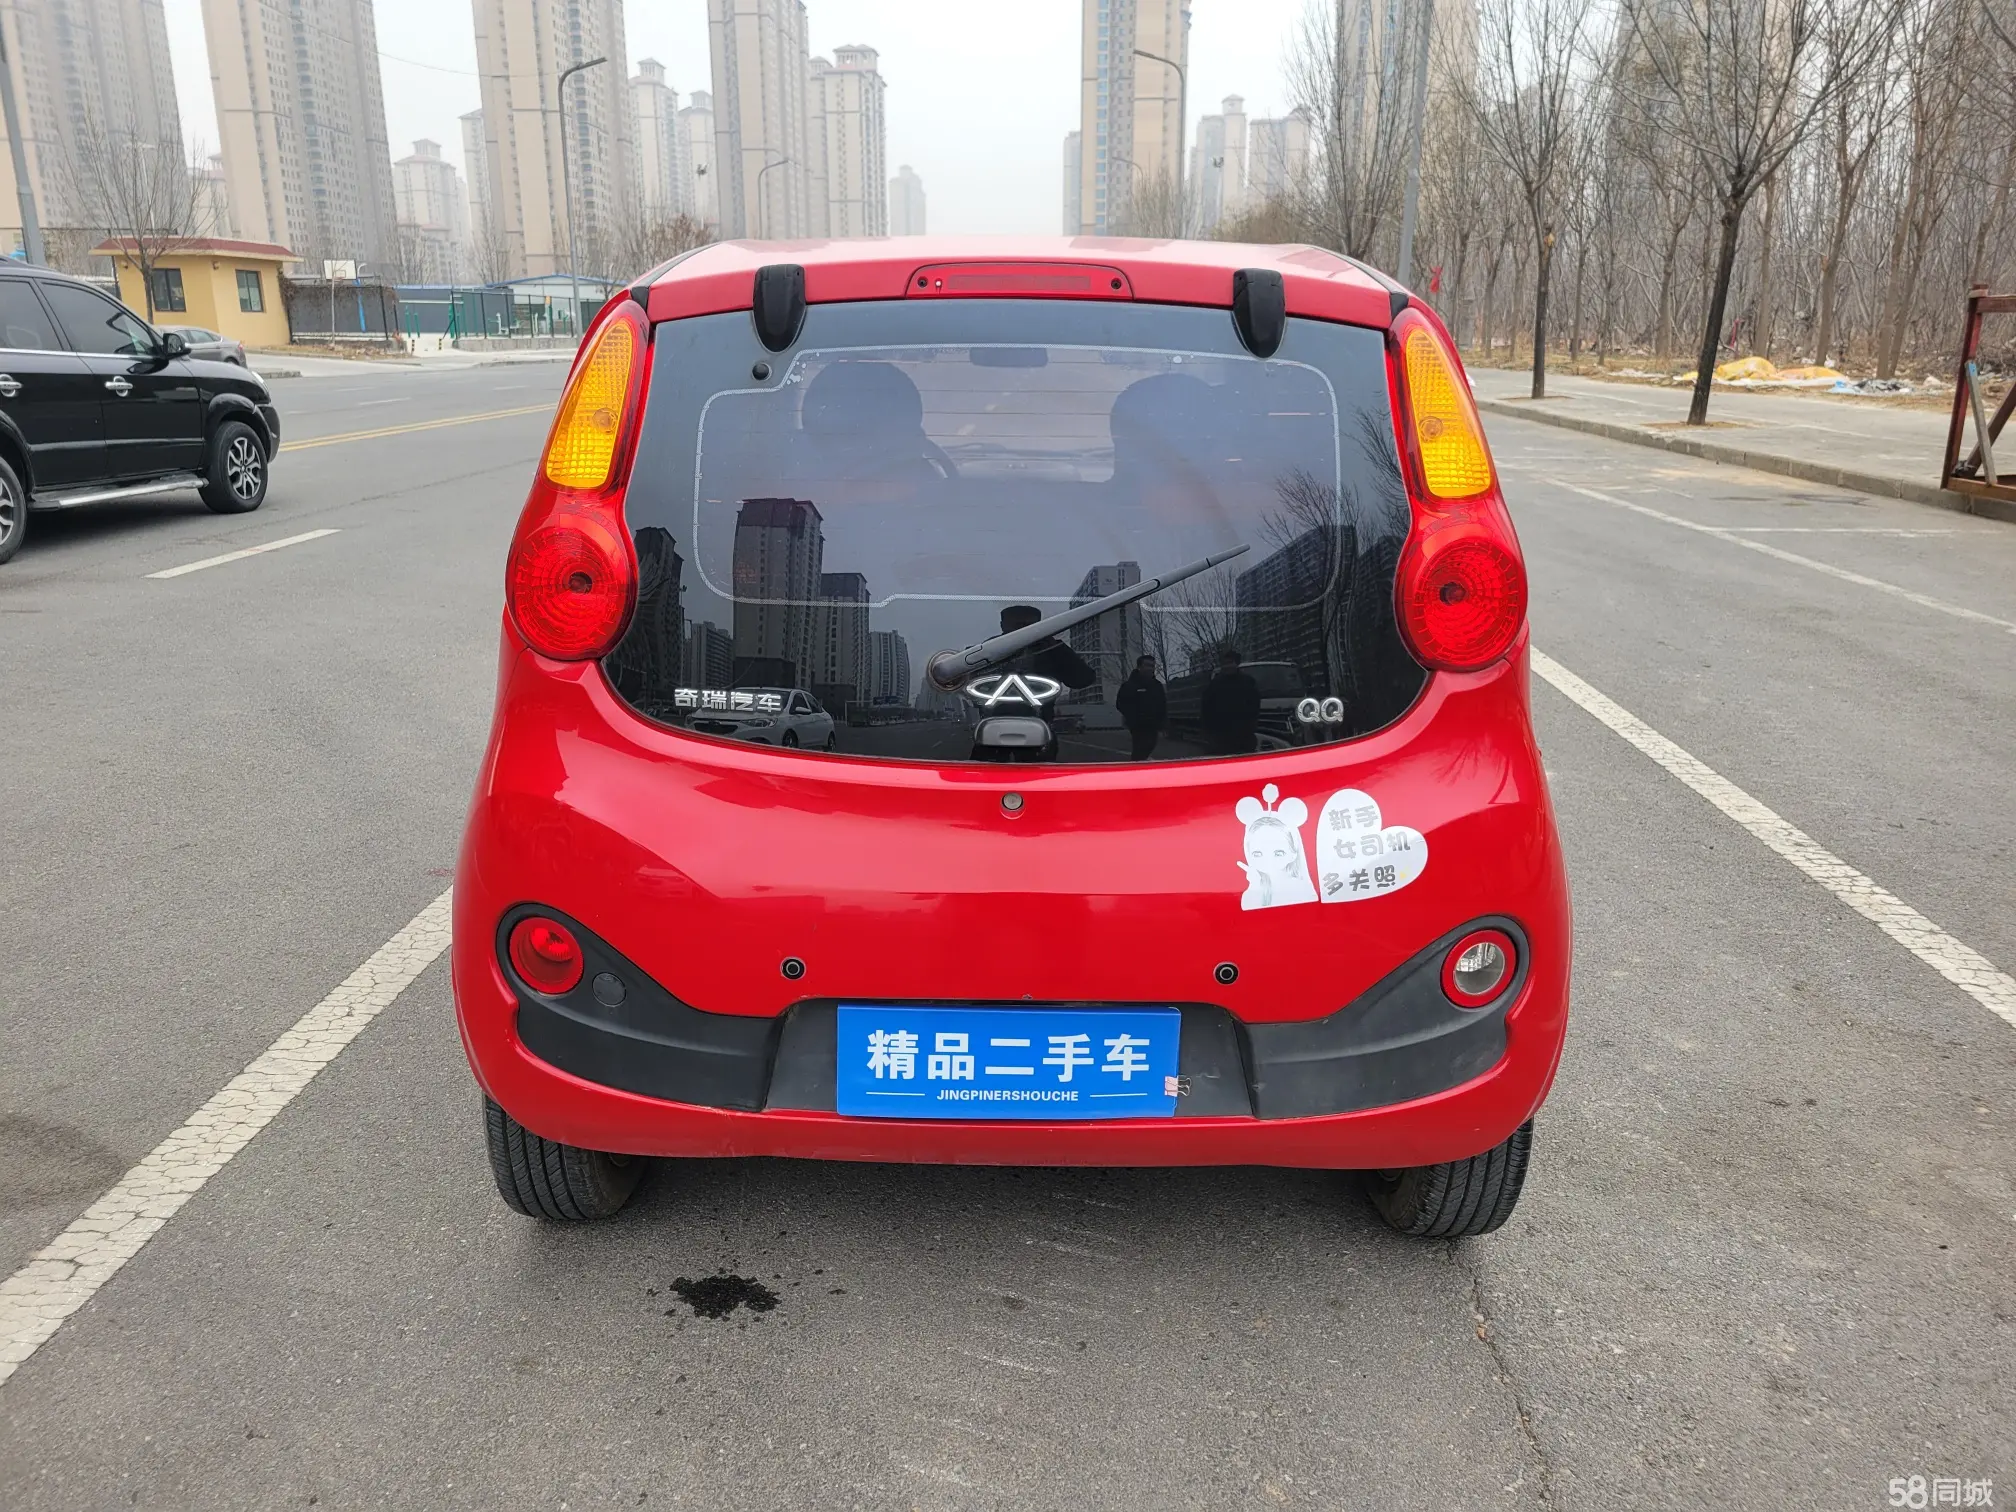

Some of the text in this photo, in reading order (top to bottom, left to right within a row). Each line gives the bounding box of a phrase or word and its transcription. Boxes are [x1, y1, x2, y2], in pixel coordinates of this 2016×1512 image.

[674, 688, 782, 713] 奇瑞汽车
[1297, 697, 1344, 723] QQ
[1328, 804, 1380, 831] 新手
[1333, 831, 1411, 860] 女司机
[1322, 864, 1396, 896] 多关照
[866, 1029, 1151, 1083] 精品二手车
[936, 1089, 1079, 1102] JINGPINERSHOUCHE
